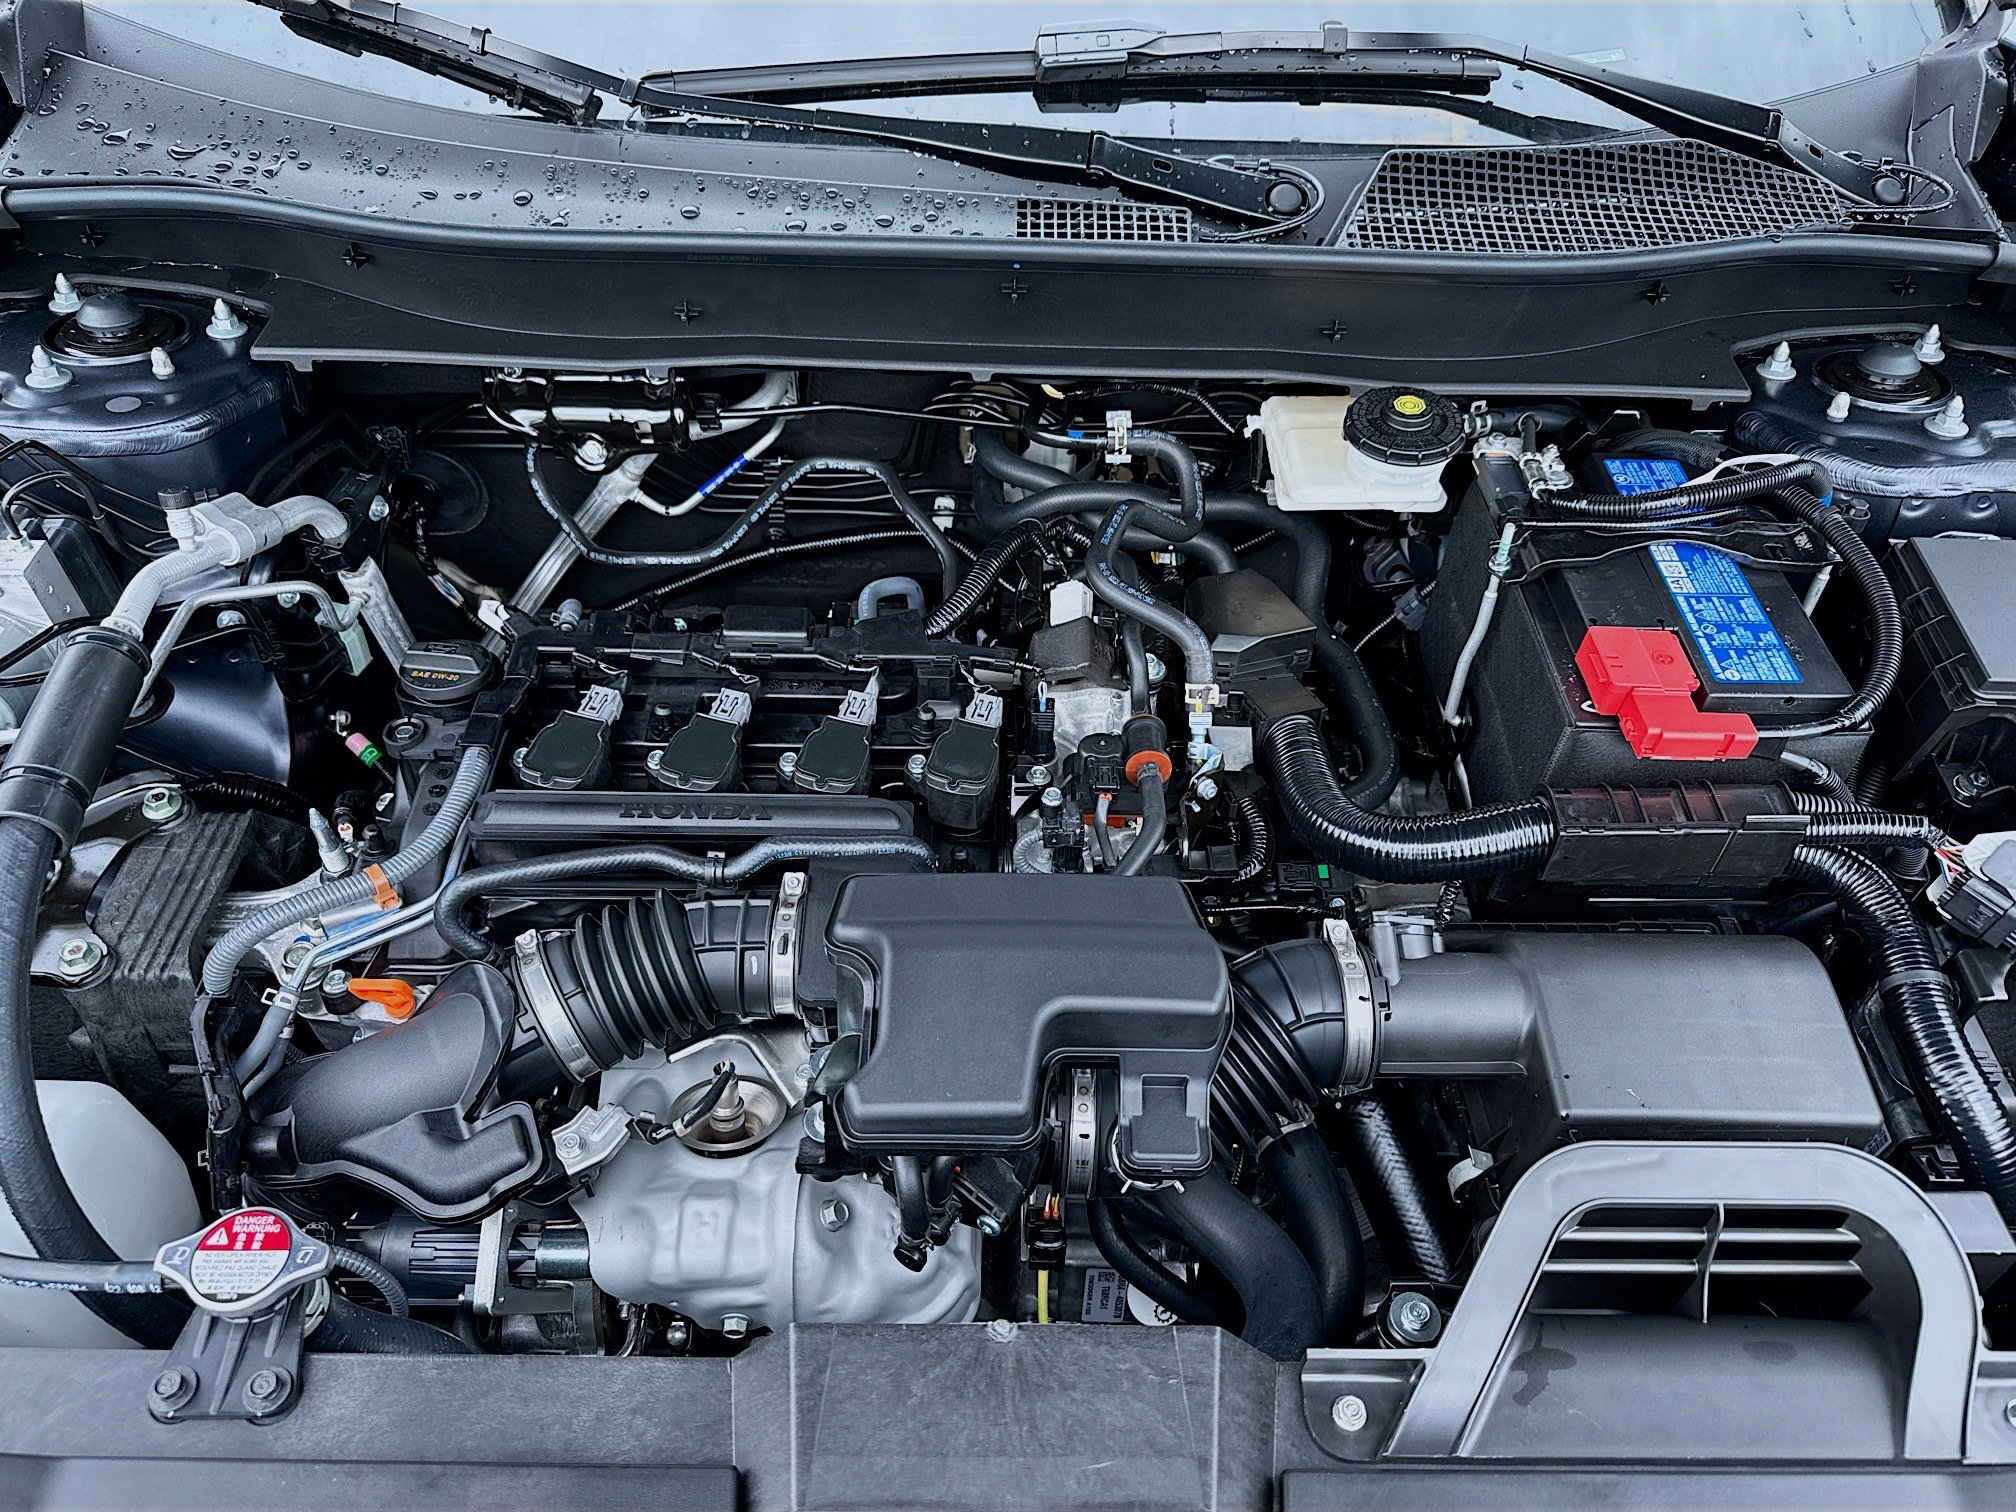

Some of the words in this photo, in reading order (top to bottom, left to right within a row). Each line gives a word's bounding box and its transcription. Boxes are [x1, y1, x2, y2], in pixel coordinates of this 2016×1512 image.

[411, 671, 432, 679] SAE
[432, 672, 460, 681] 0W-20
[619, 802, 774, 821] HONDA
[234, 1215, 275, 1225] DANGER
[232, 1224, 281, 1233] WARNUNG
